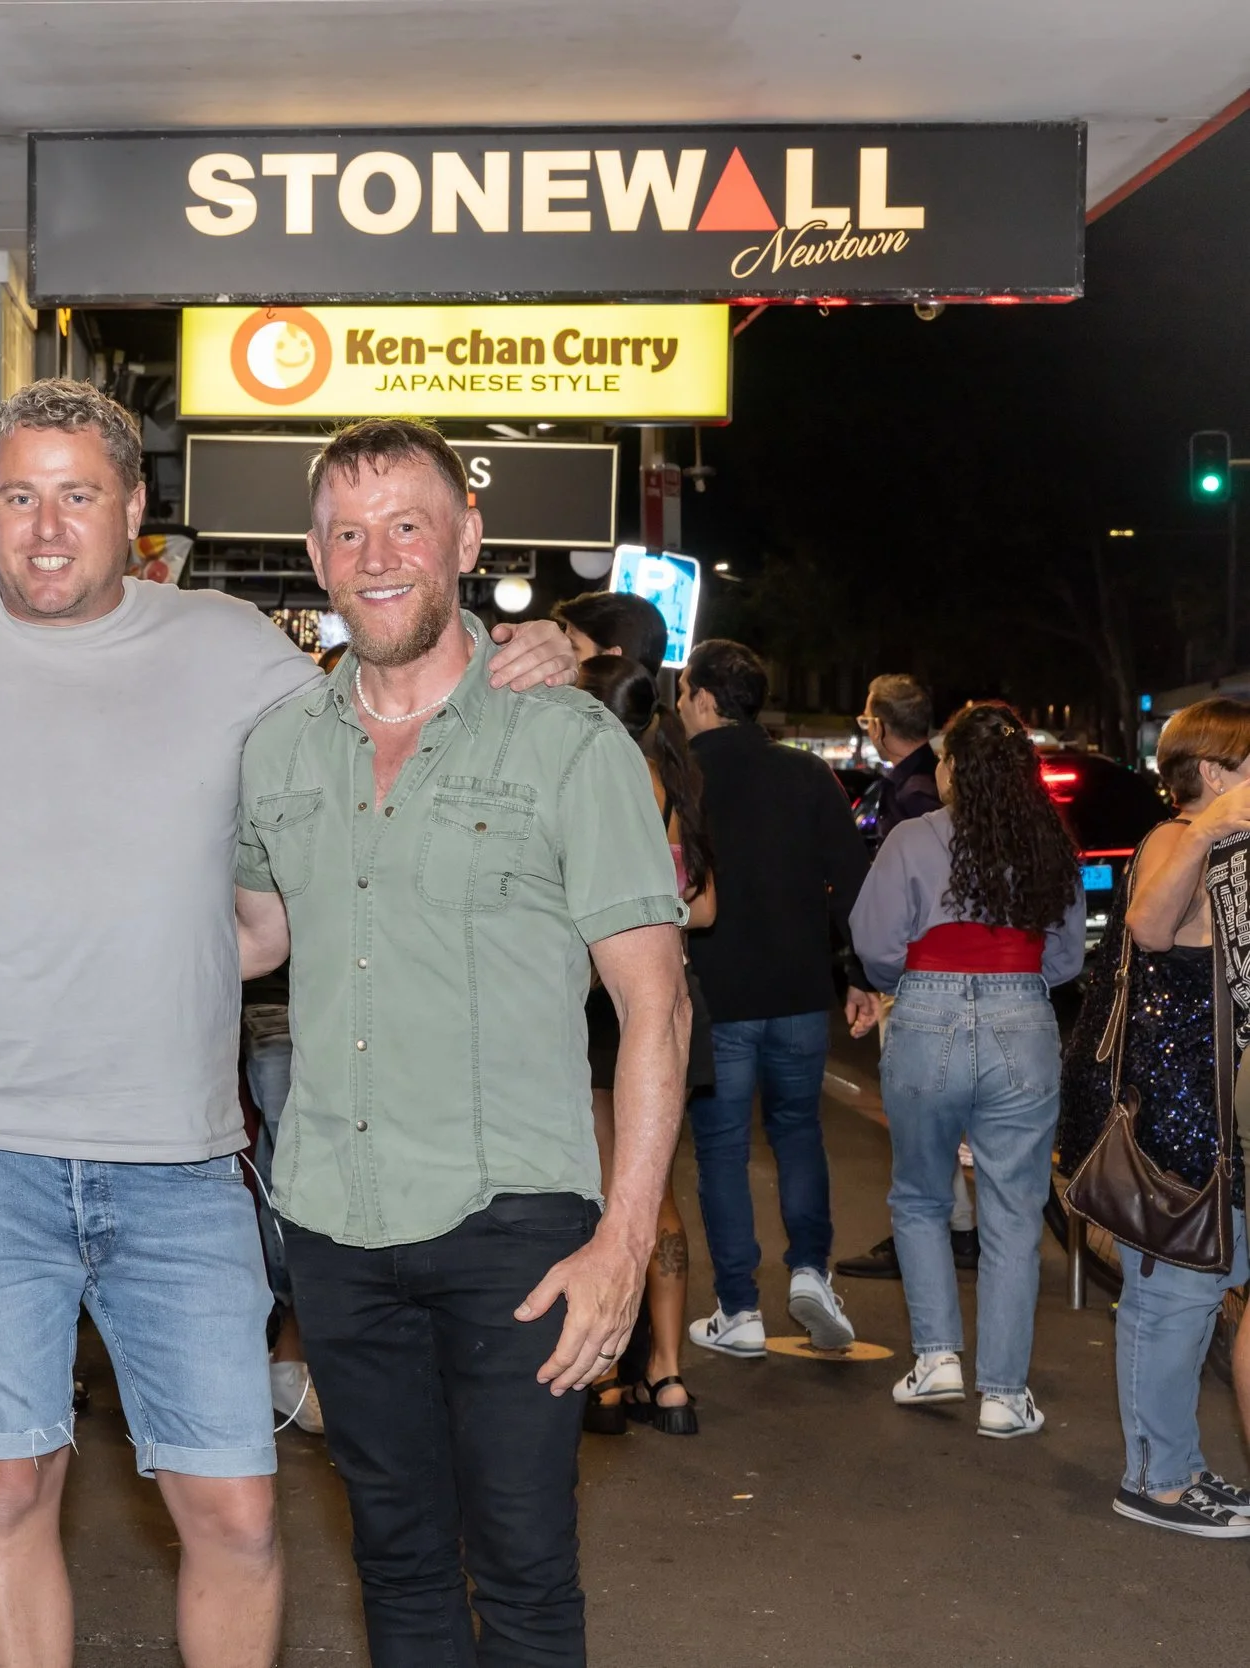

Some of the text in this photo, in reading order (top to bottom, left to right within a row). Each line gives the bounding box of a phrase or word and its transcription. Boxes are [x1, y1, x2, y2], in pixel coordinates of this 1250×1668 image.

[185, 146, 926, 236] STONEWALL
[730, 219, 910, 279] Newtown
[345, 328, 679, 373] Ken-chan Curry
[375, 374, 621, 392] JAPANESE STYLE
